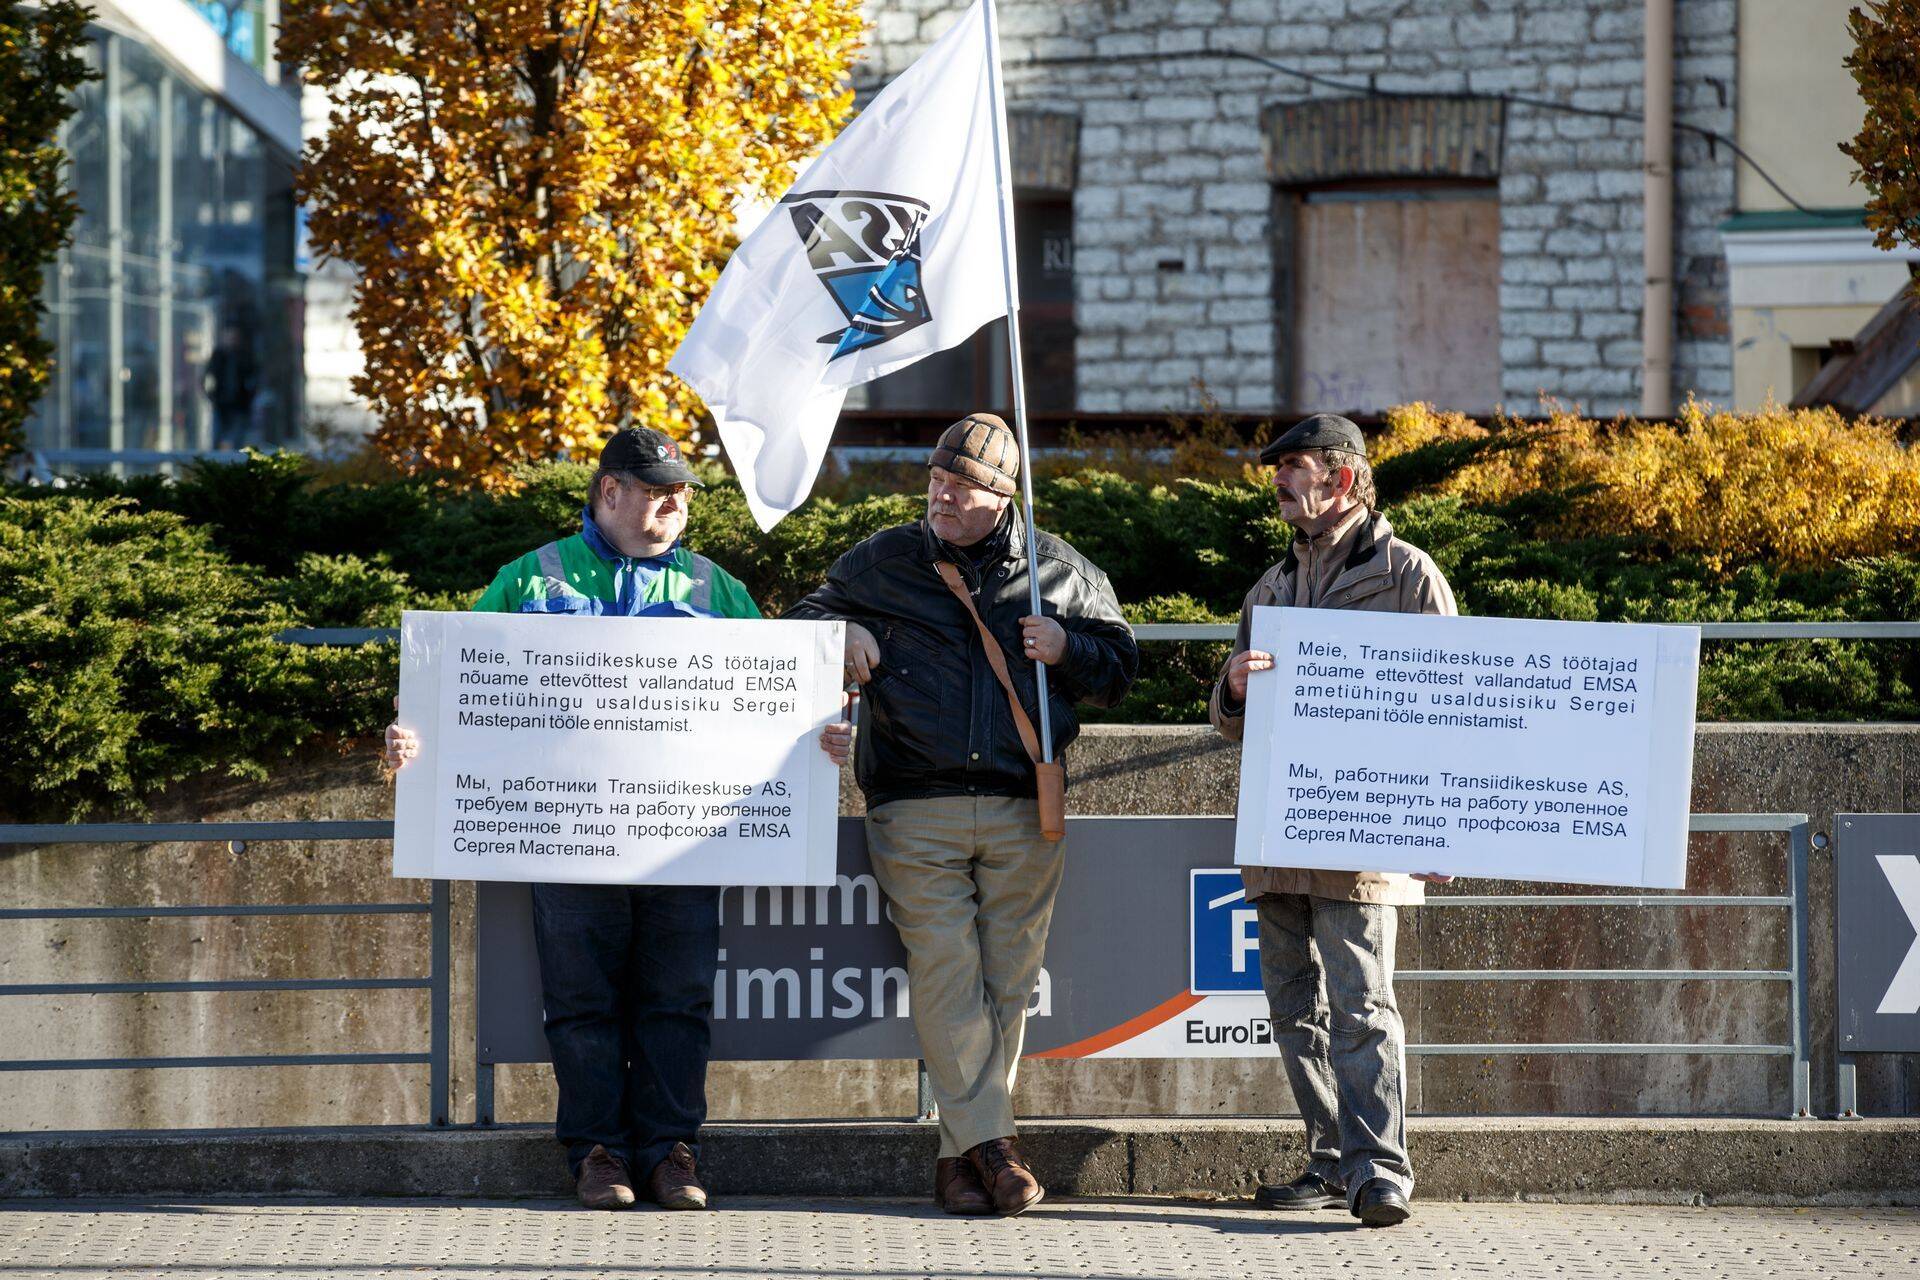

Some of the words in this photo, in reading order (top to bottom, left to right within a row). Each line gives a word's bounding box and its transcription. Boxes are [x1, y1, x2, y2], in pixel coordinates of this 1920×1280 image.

[460, 647, 510, 667] Meie,
[522, 649, 678, 669] Transiidikeskuse
[687, 654, 714, 670] AS
[724, 655, 797, 675] töötajad
[1298, 640, 1347, 661] Meie,
[1359, 644, 1515, 668] Transiidikeskuse
[1524, 653, 1551, 670] AS
[1562, 655, 1638, 676] töötajad
[459, 669, 529, 687] nõuame
[539, 672, 628, 689] ettevõttest
[638, 674, 734, 691] vallandatud
[745, 676, 797, 692] EMSA
[1296, 662, 1365, 680] nõuame
[1375, 667, 1464, 686] ettevõttest
[1474, 672, 1572, 691] vallandatud
[1583, 675, 1638, 693] EMSA
[458, 691, 583, 713] ametiühingu
[596, 695, 720, 712] usaldusisiku
[732, 696, 797, 717] Sergei
[1294, 683, 1418, 707] ametiühingu
[1431, 691, 1556, 710] usaldusisiku
[1569, 695, 1635, 716] Sergei
[458, 710, 546, 732] Mastepani
[548, 713, 590, 731] tööle
[593, 715, 693, 732] ennistamist.
[1293, 702, 1380, 723] Mastepani
[1383, 707, 1425, 725] tööle
[1427, 711, 1528, 730] ennistamist.
[456, 773, 491, 792] Мы,
[502, 776, 597, 795] работники
[607, 778, 753, 796] Transiidikeskuse
[761, 780, 792, 799] AS,
[1288, 762, 1323, 782] Мы,
[1334, 767, 1429, 786] работники
[1439, 772, 1588, 794] Transiidikeskuse
[1596, 779, 1629, 799] AS,
[454, 795, 528, 815] требуем
[534, 801, 604, 818] вернуть
[609, 803, 630, 815] на
[636, 800, 696, 820] работу
[701, 804, 792, 820] уволенное
[1287, 785, 1360, 804] требуем
[1365, 791, 1435, 810] вернуть
[1440, 796, 1462, 808] на
[1467, 795, 1529, 815] работу
[1533, 800, 1629, 817] уволенное
[453, 819, 562, 836] доверенное
[572, 823, 616, 839] лицо
[627, 821, 727, 841] профсоюза
[738, 822, 792, 838] EMSA
[1284, 807, 1392, 825] доверенное
[1402, 814, 1447, 830] лицо
[1458, 816, 1560, 835] профсоюза
[1572, 819, 1627, 838] EMSA
[1284, 824, 1346, 845] Сергея
[1349, 827, 1450, 848] Мастепана.
[453, 836, 516, 857] Сергея
[519, 839, 620, 857] Мастепана.
[1186, 1018, 1279, 1045] EuroP
